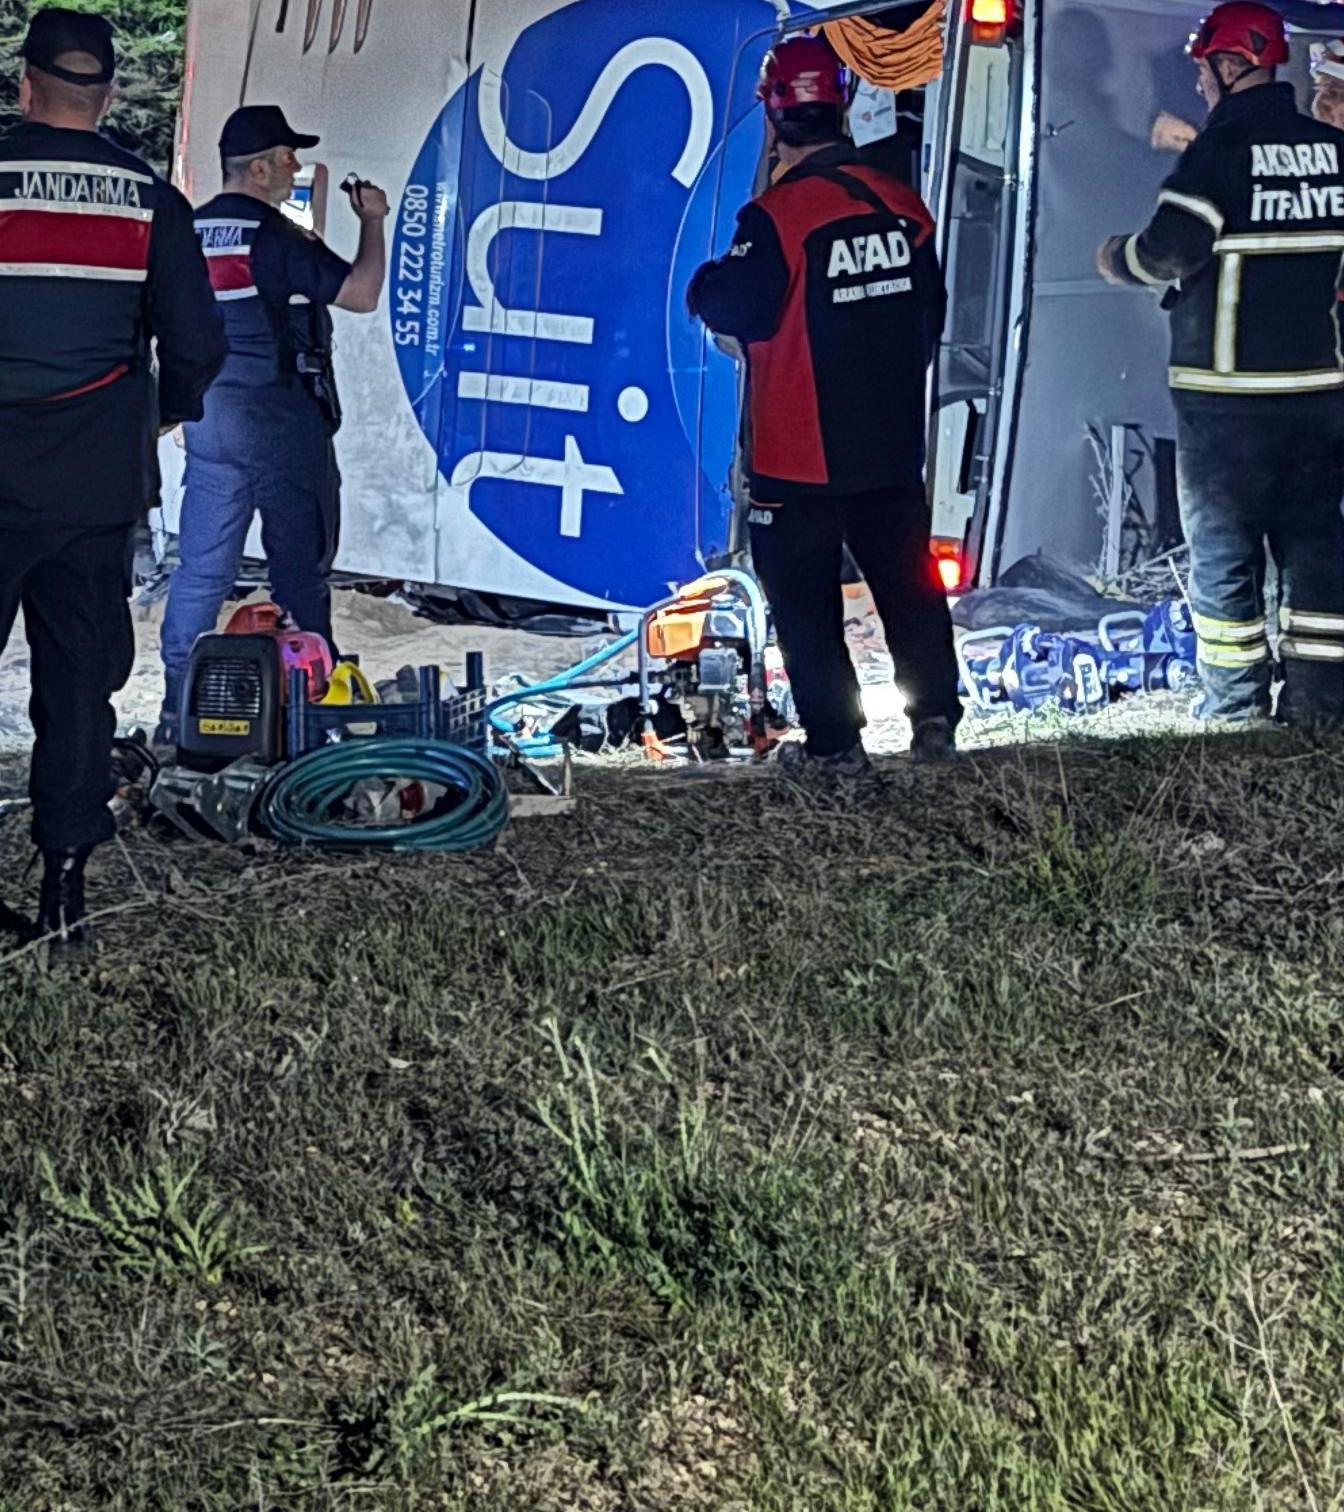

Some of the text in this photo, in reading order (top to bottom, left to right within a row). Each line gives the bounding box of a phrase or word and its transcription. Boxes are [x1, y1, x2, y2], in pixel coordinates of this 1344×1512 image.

[14, 170, 141, 209] JANDARMA
[395, 184, 429, 346] 0850 222 34 55
[451, 36, 714, 538] Suit
[827, 230, 911, 278] AFAD
